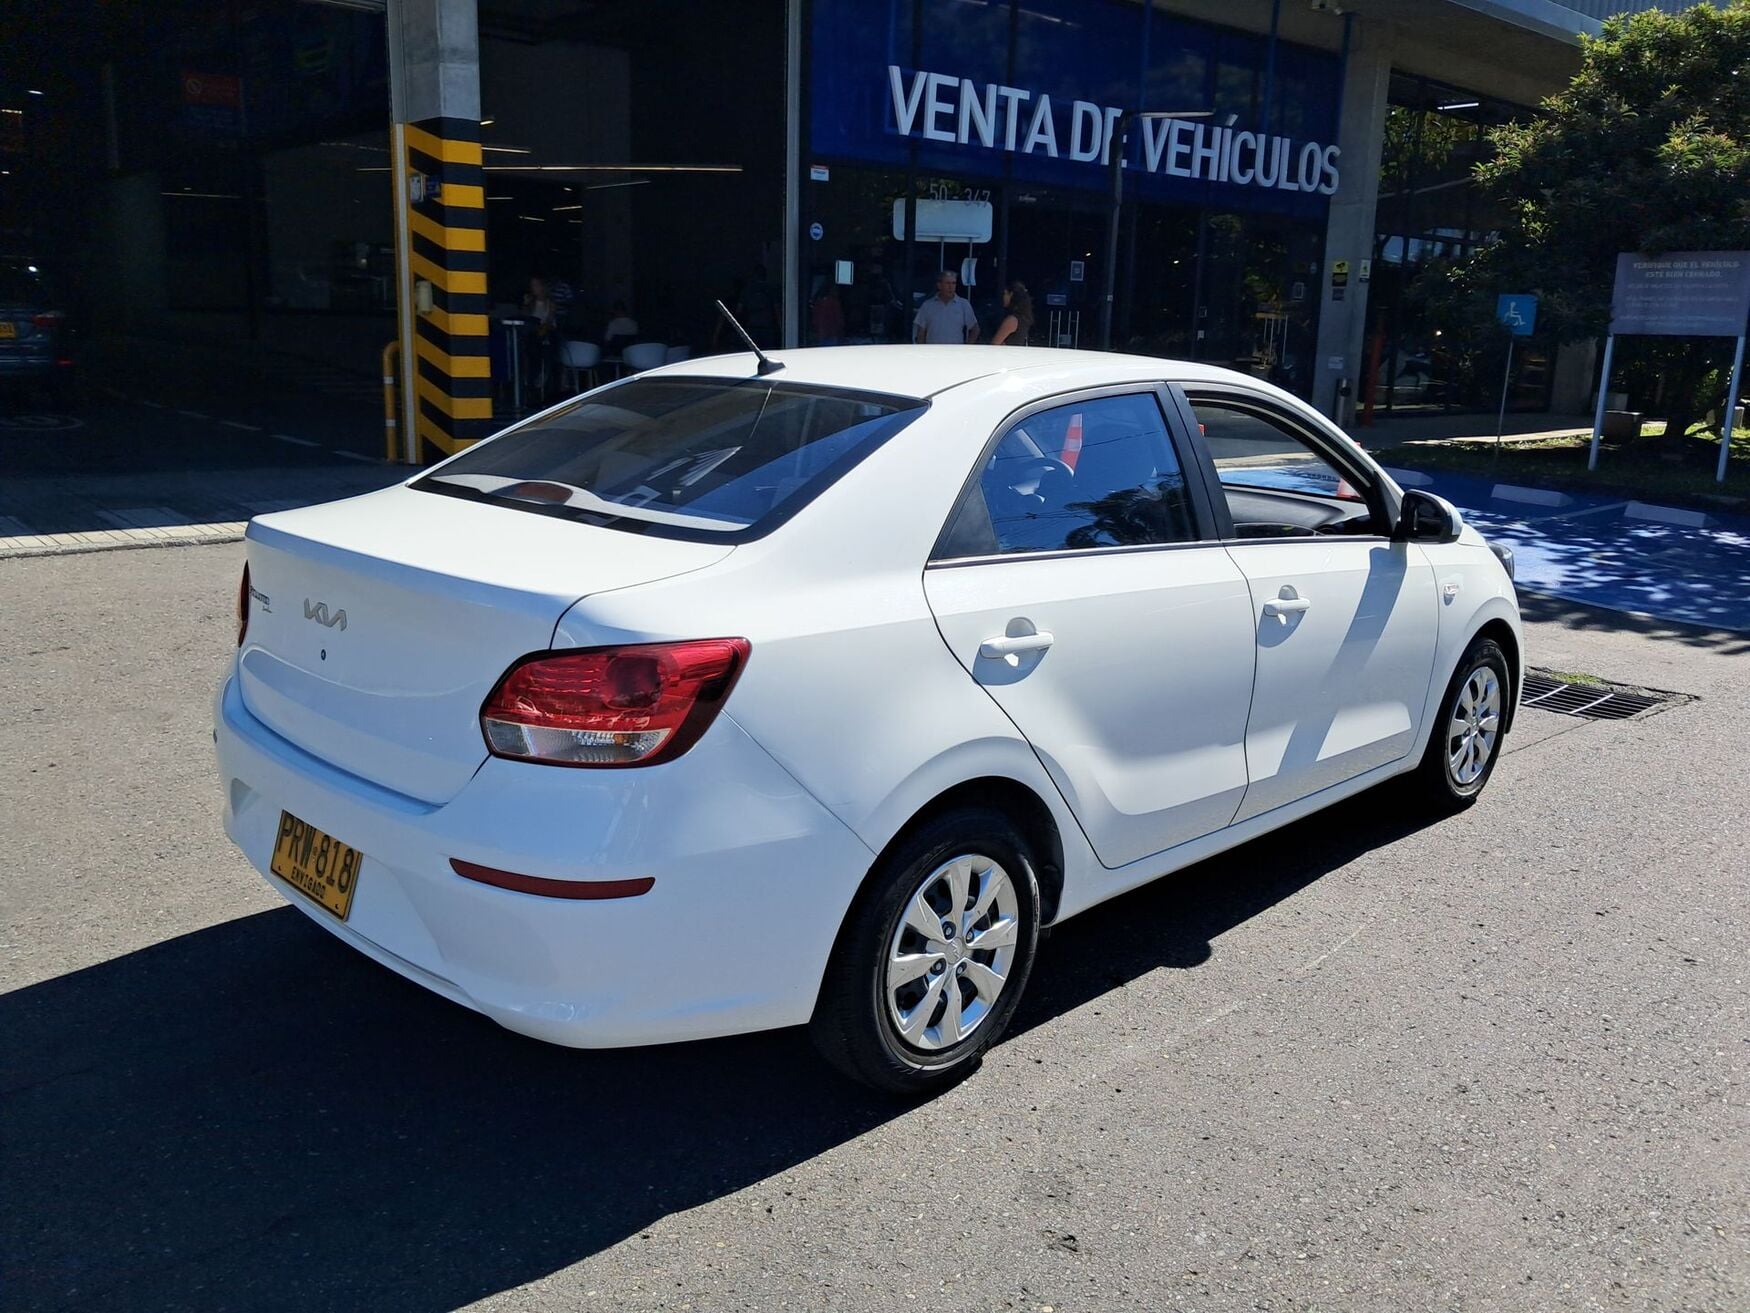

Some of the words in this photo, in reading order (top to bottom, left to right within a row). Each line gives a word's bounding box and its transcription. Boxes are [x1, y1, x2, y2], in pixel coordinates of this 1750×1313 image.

[888, 65, 1059, 158] VENTA
[1141, 113, 1341, 195] VEHÍCULOS
[303, 597, 348, 632] KIA
[290, 865, 327, 899] ENVIGADO
